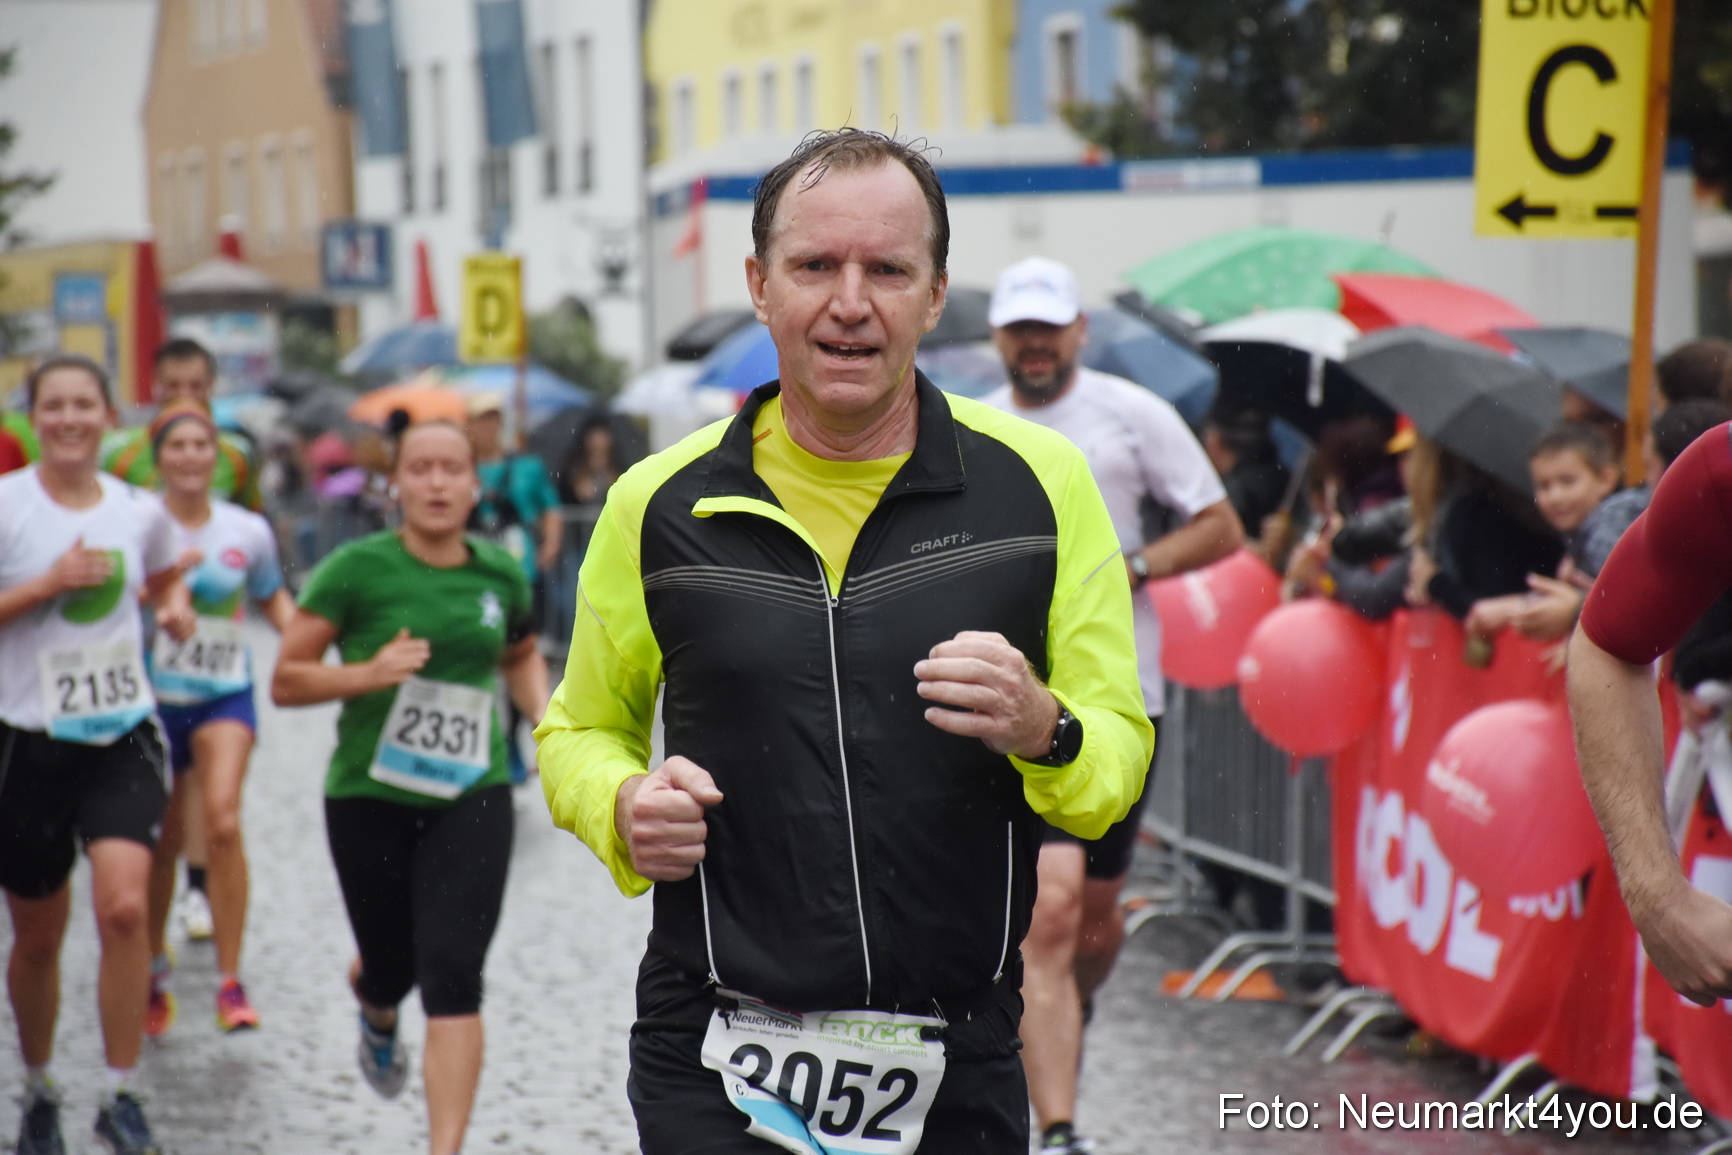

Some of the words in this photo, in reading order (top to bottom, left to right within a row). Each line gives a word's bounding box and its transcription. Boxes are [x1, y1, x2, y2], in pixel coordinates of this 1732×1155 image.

[1527, 44, 1617, 177] C
[910, 533, 960, 554] CRAFT
[56, 663, 140, 712] 2135
[396, 705, 480, 759] 2331
[817, 1033, 852, 1046] inspired
[854, 1040, 864, 1050] by
[867, 1043, 891, 1053] smart
[893, 1048, 928, 1058] concepts
[735, 1083, 744, 1096] C
